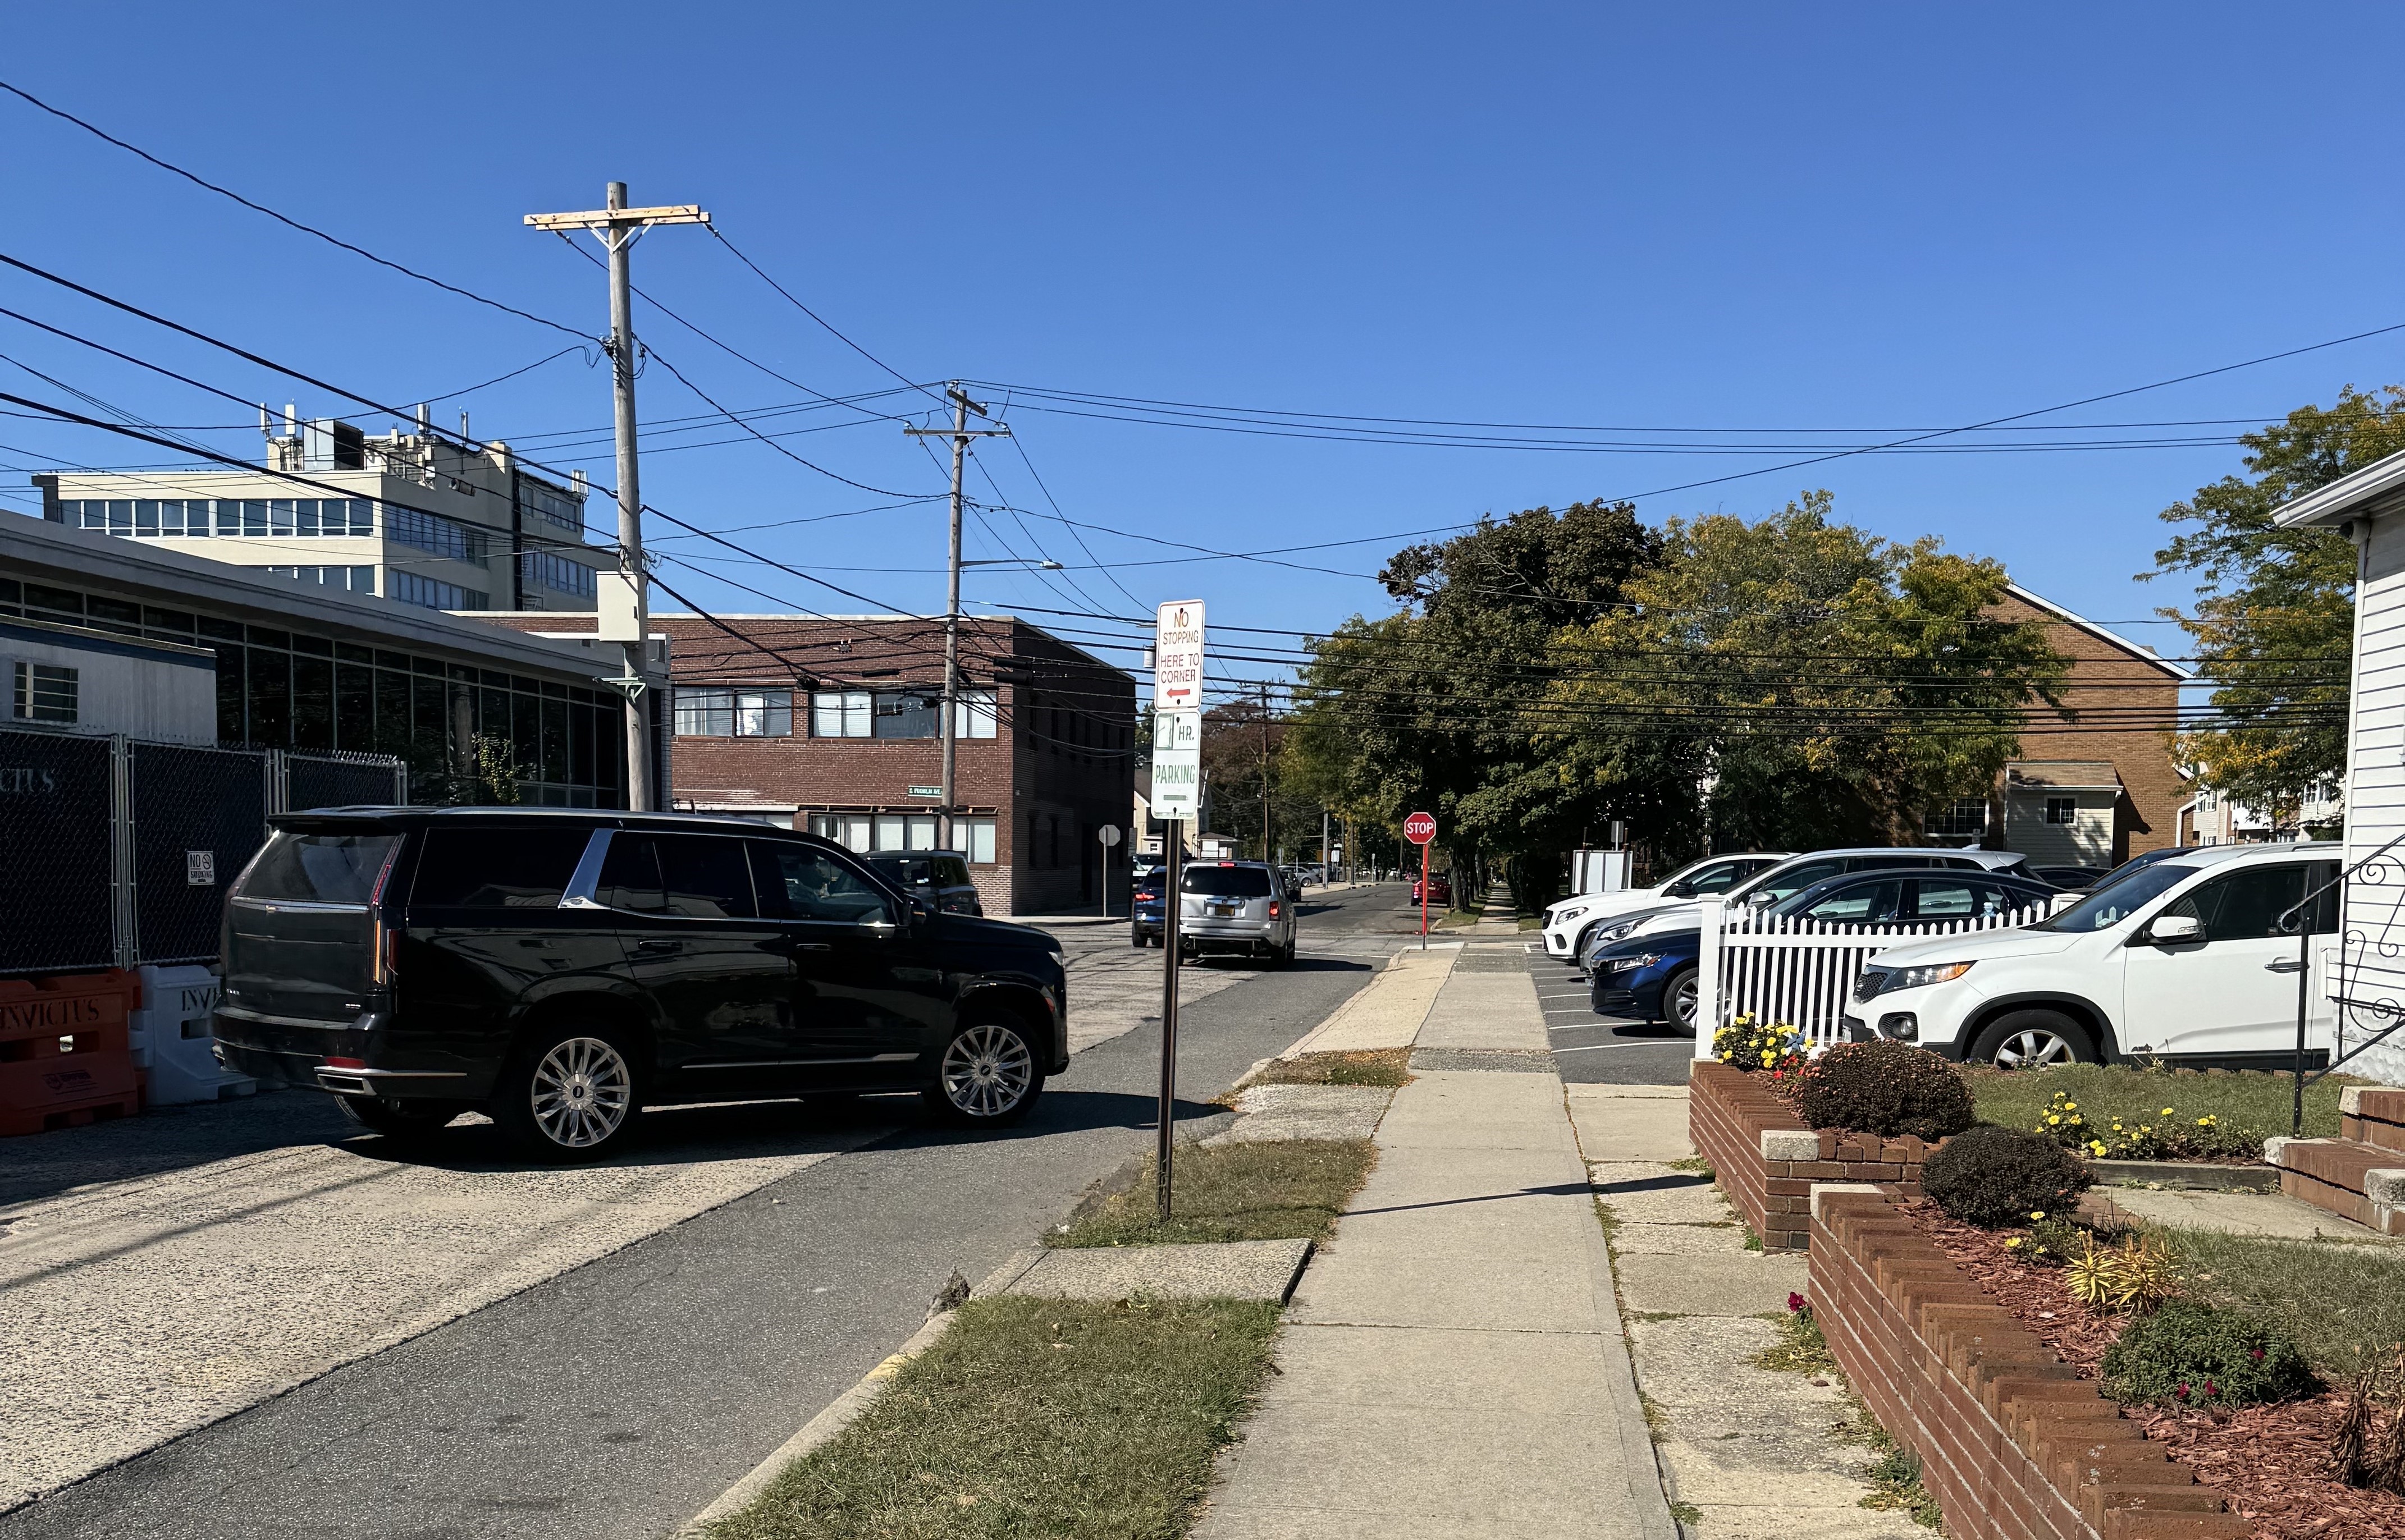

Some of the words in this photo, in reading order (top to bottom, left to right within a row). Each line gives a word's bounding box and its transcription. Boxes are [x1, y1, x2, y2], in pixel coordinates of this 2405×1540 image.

[1174, 611, 1189, 628] NO
[1163, 630, 1199, 645] STOPPING
[1160, 654, 1184, 668] HERE
[1188, 653, 1200, 666] TO
[1161, 669, 1196, 684] CORNER
[1178, 726, 1194, 741] HR.
[1155, 764, 1195, 784] PARKING
[1406, 822, 1434, 834] STOP
[190, 854, 201, 868] NO
